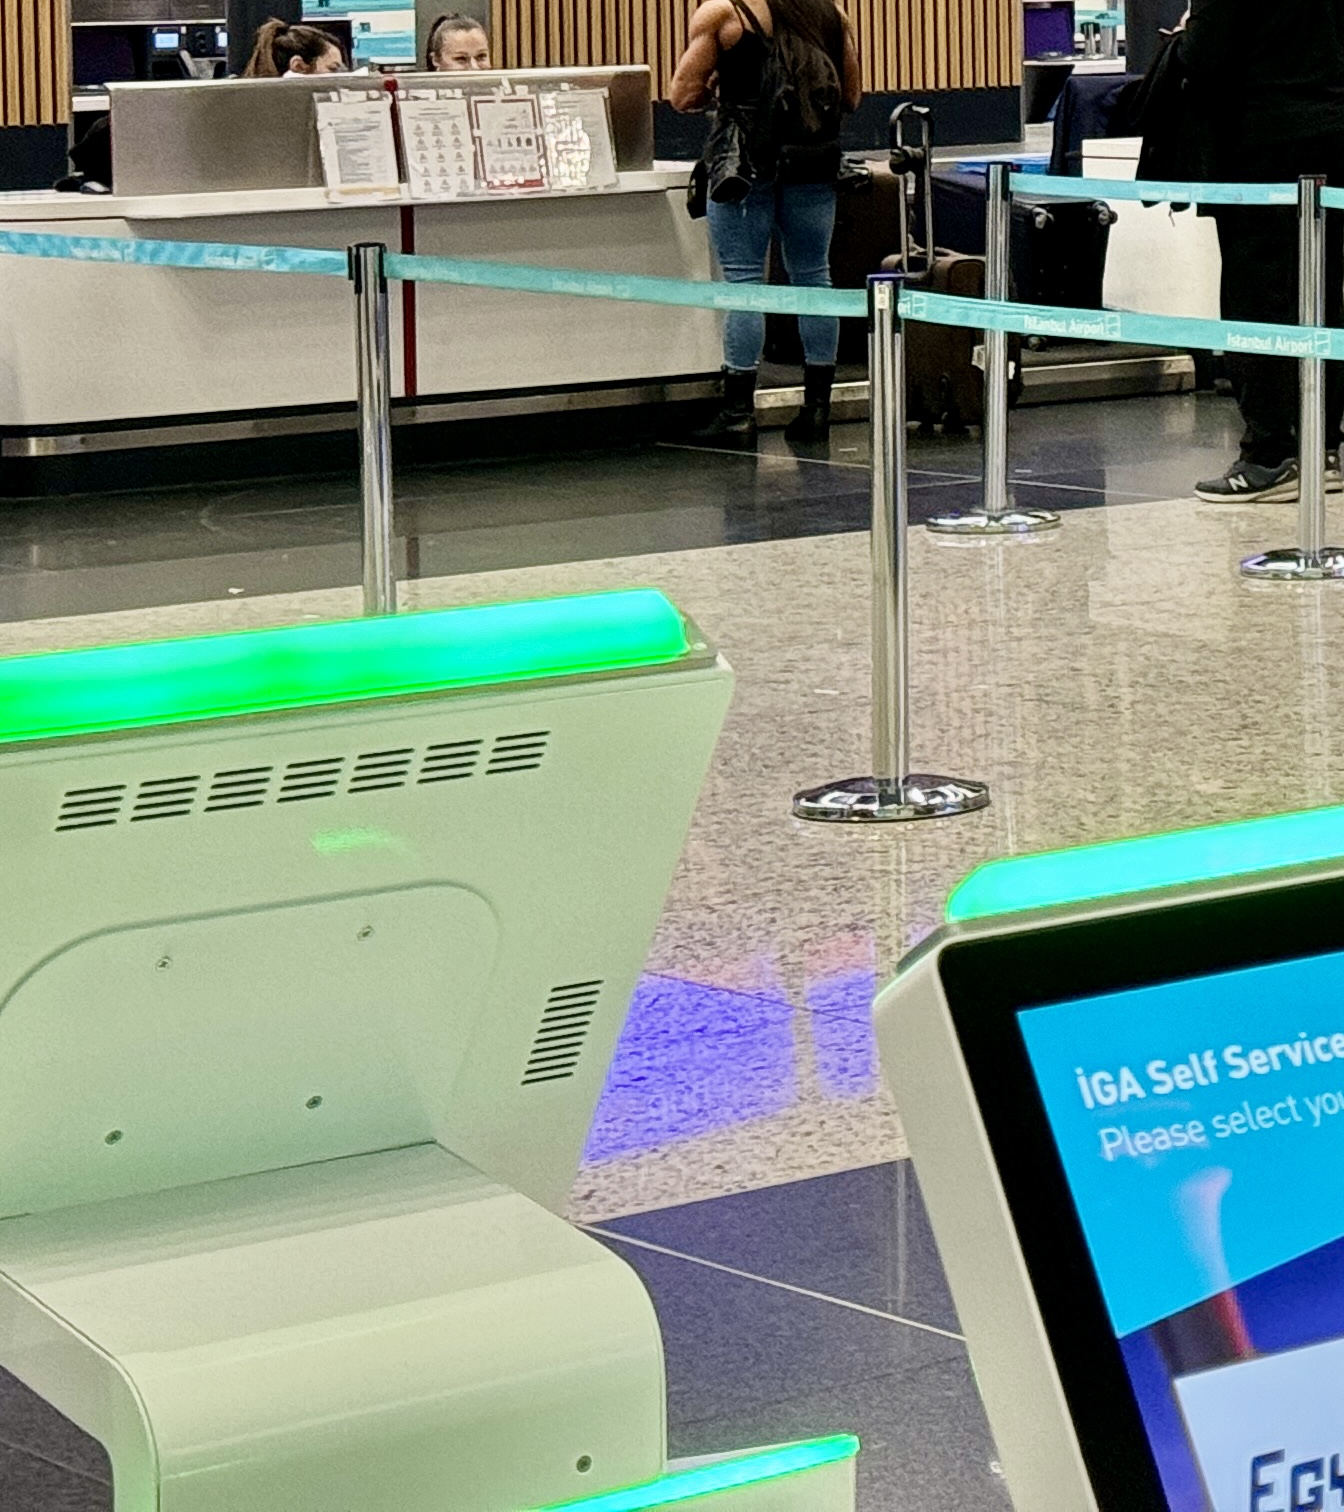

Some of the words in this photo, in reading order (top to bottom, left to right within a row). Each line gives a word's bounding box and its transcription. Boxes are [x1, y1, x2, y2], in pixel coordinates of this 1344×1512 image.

[1069, 319, 1106, 336] Airport
[1227, 332, 1273, 351] Istanbul
[1275, 335, 1314, 355] Airport
[1228, 473, 1249, 491] N
[1075, 1067, 1146, 1109] İGA
[1147, 1049, 1219, 1095] Self
[1099, 1117, 1207, 1161] Please
[1212, 1095, 1302, 1139] select
